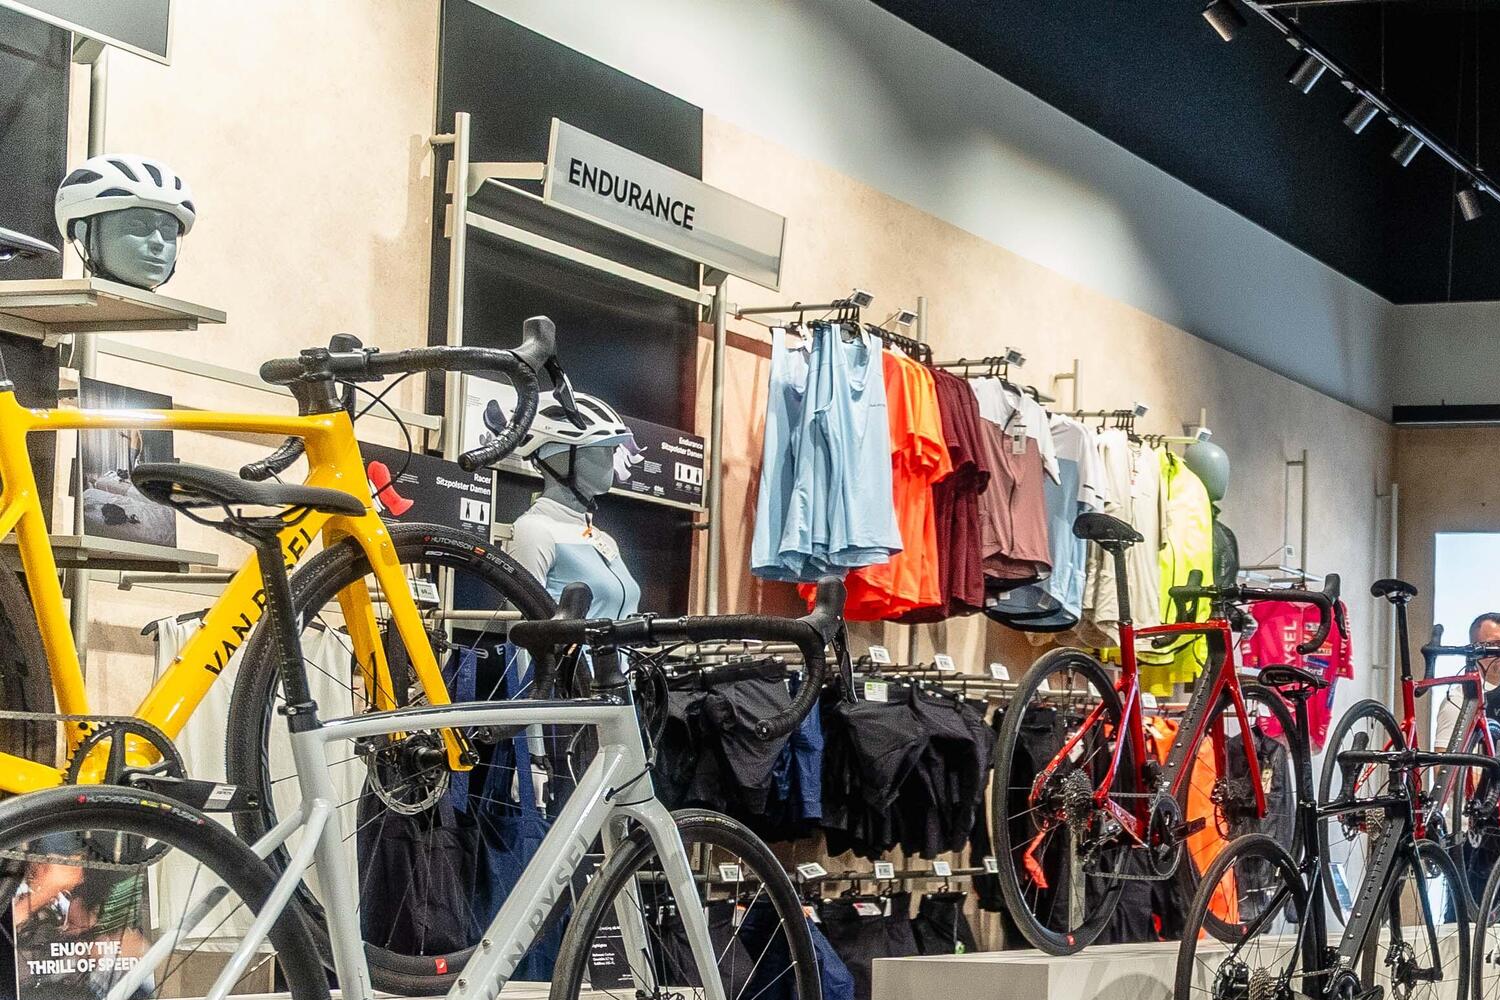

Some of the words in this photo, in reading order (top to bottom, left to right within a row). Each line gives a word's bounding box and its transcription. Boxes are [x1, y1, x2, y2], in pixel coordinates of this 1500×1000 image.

[568, 157, 696, 231] ENDURANCE
[435, 476, 470, 492] Sitzpolster
[469, 483, 492, 496] Damen
[473, 472, 492, 484] Racer
[204, 612, 253, 675] VAN
[252, 528, 312, 613] REL
[1283, 620, 1298, 668] YSEL
[528, 833, 590, 936] RYSEL
[27, 959, 76, 975] THRILL
[77, 958, 97, 974] OF
[98, 956, 142, 972] SPEED
[50, 941, 95, 957] ENJOY
[95, 940, 122, 955] THE
